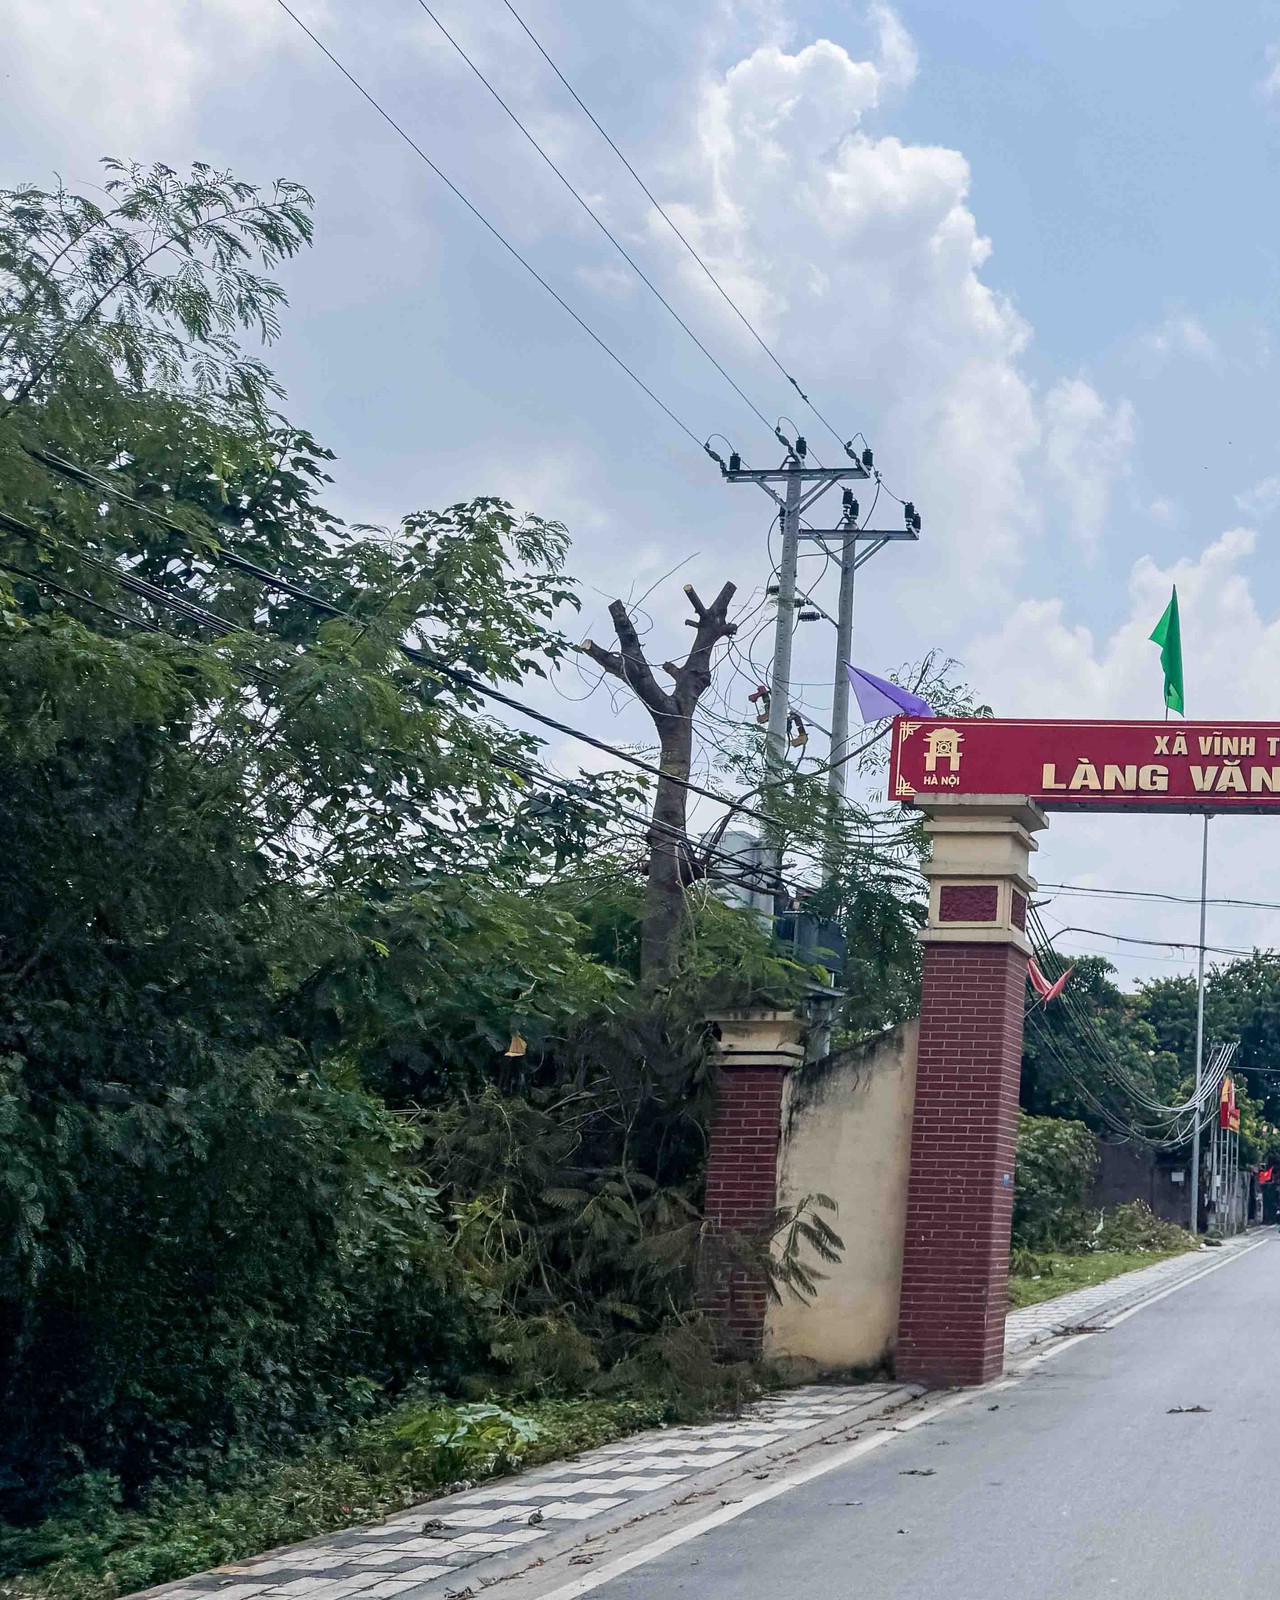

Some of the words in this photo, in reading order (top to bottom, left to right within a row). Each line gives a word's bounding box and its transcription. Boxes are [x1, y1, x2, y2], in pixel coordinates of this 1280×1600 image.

[1153, 731, 1188, 755] XÃ
[1198, 731, 1256, 756] VĨNH
[923, 773, 938, 785] HÀ
[941, 774, 960, 787] NỘI
[1042, 757, 1169, 791] LÀNG
